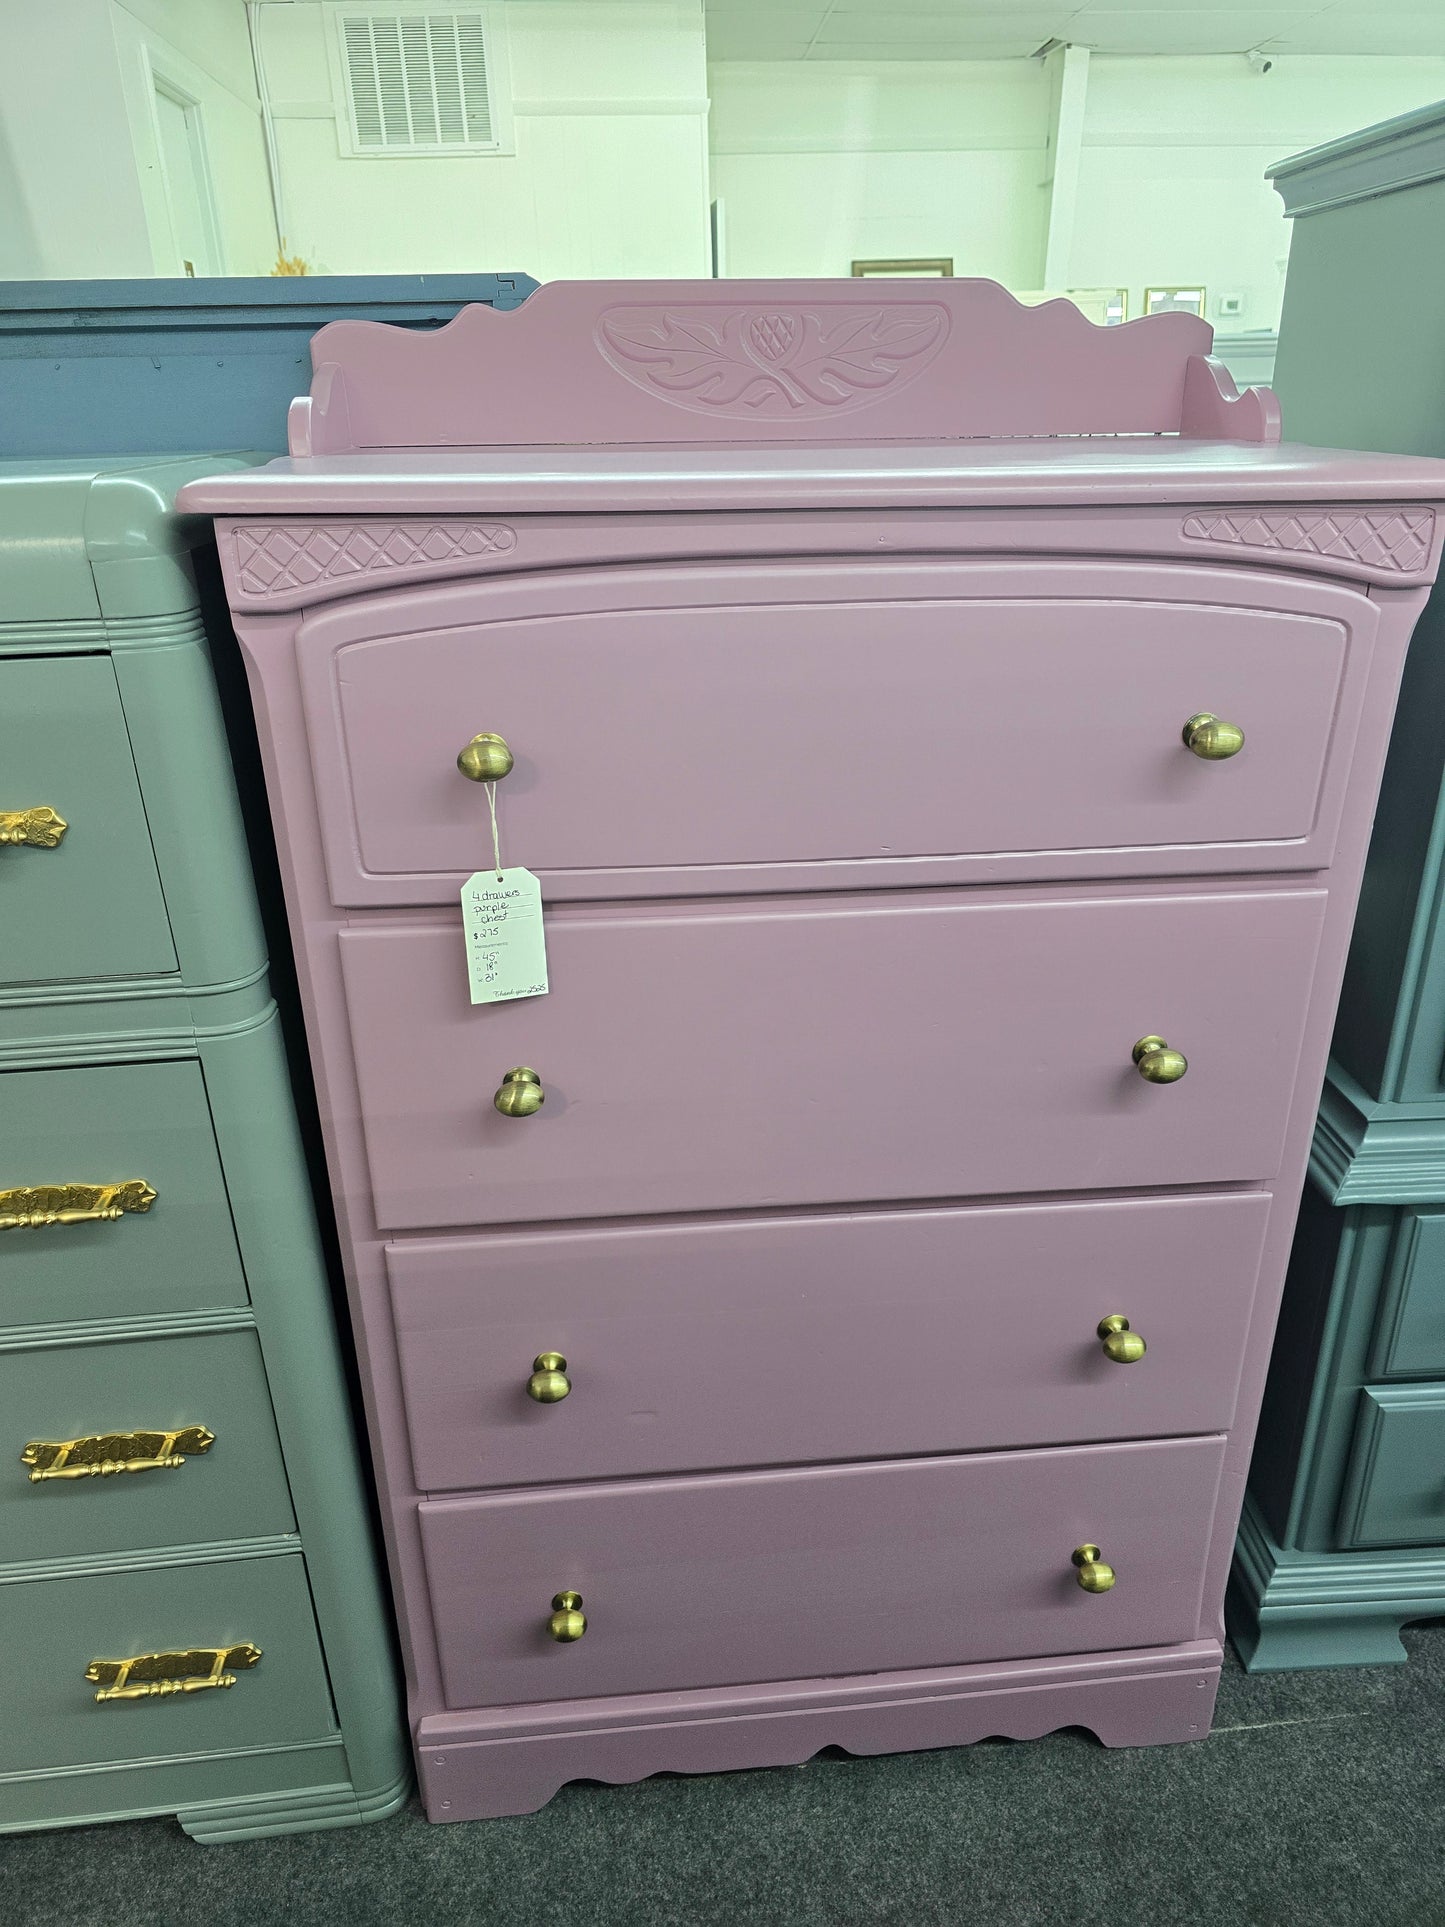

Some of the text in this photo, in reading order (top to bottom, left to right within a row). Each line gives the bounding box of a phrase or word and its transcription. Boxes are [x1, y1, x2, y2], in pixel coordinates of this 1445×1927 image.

[472, 889, 521, 901] 4 drawers
[473, 902, 510, 916] purple
[481, 910, 509, 924] chest
